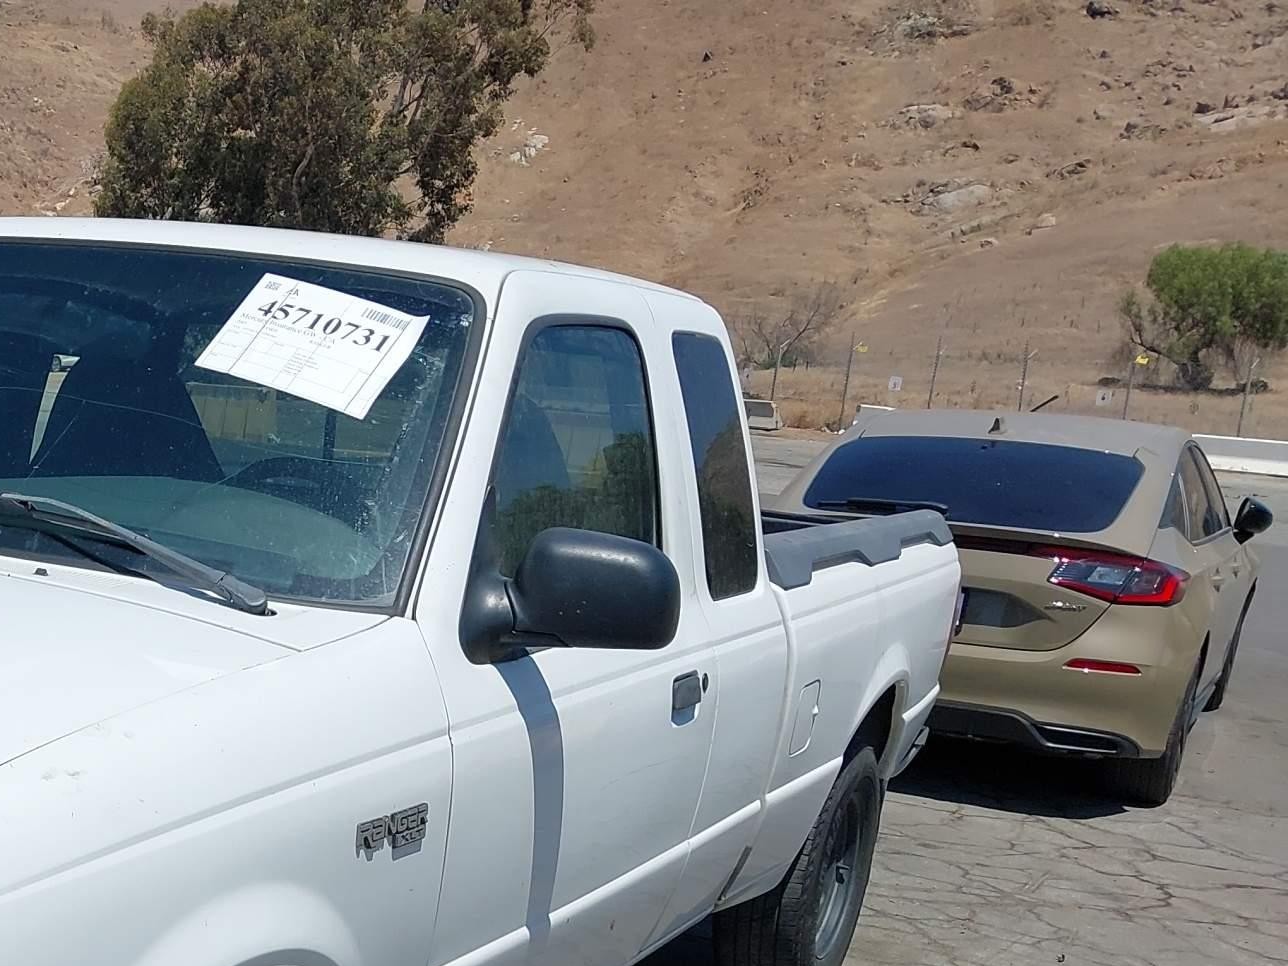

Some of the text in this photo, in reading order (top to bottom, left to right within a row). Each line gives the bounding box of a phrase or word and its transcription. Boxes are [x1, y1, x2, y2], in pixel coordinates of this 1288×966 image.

[257, 299, 392, 353] 45710731
[356, 802, 429, 850] RANGER
[396, 826, 426, 847] XLT
